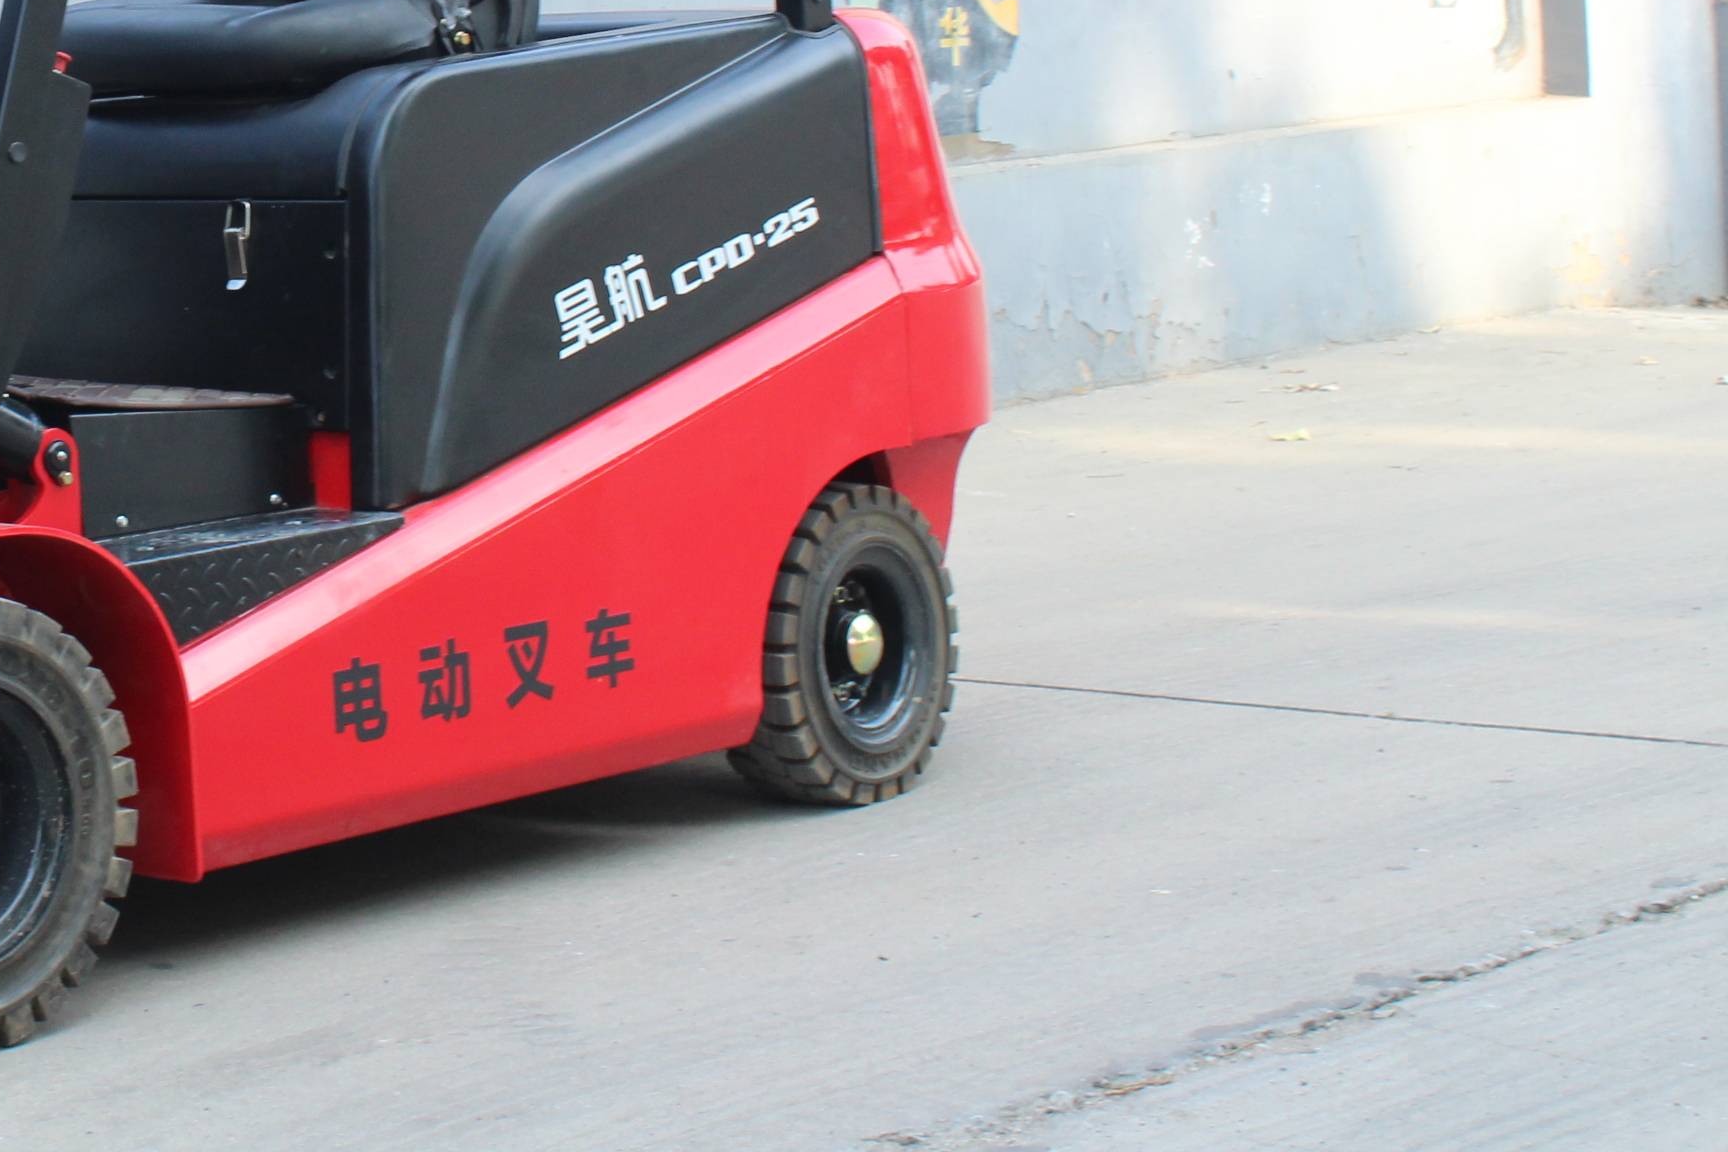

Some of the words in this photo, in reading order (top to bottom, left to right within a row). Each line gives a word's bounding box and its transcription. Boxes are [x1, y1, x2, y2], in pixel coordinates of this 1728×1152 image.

[938, 6, 971, 67] 华
[553, 253, 668, 360] 昊航
[332, 608, 635, 743] 电动叉车
